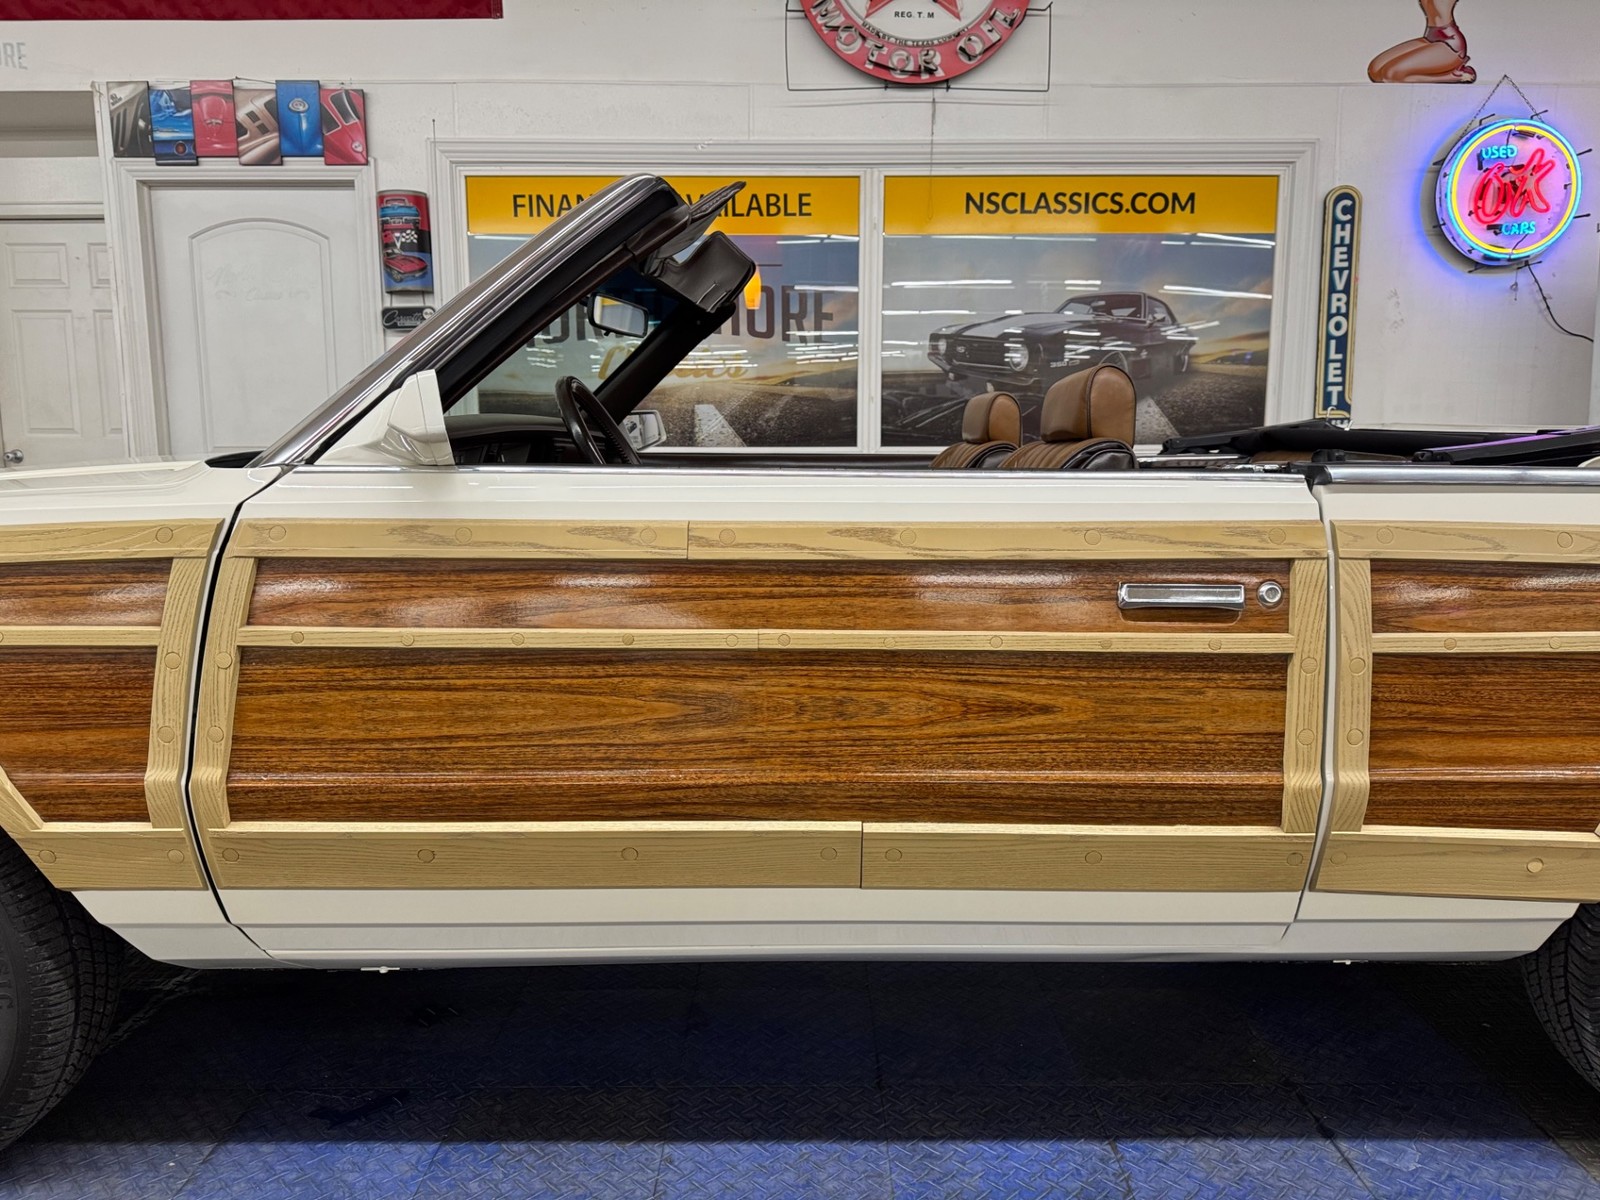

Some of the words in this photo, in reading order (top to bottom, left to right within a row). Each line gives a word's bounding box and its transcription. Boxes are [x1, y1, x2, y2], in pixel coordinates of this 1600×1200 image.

[811, 0, 945, 79] MOTOR
[956, 7, 1021, 65] OIL
[937, 26, 969, 44] COMPNY
[0, 42, 28, 70] RE
[1481, 145, 1518, 159] USED
[512, 194, 593, 217] FINA
[685, 193, 812, 217] ILABLE
[964, 191, 1196, 216] NSCLASSICS.COM
[1501, 220, 1537, 236] CARS
[1326, 199, 1353, 406] CHEVROLET
